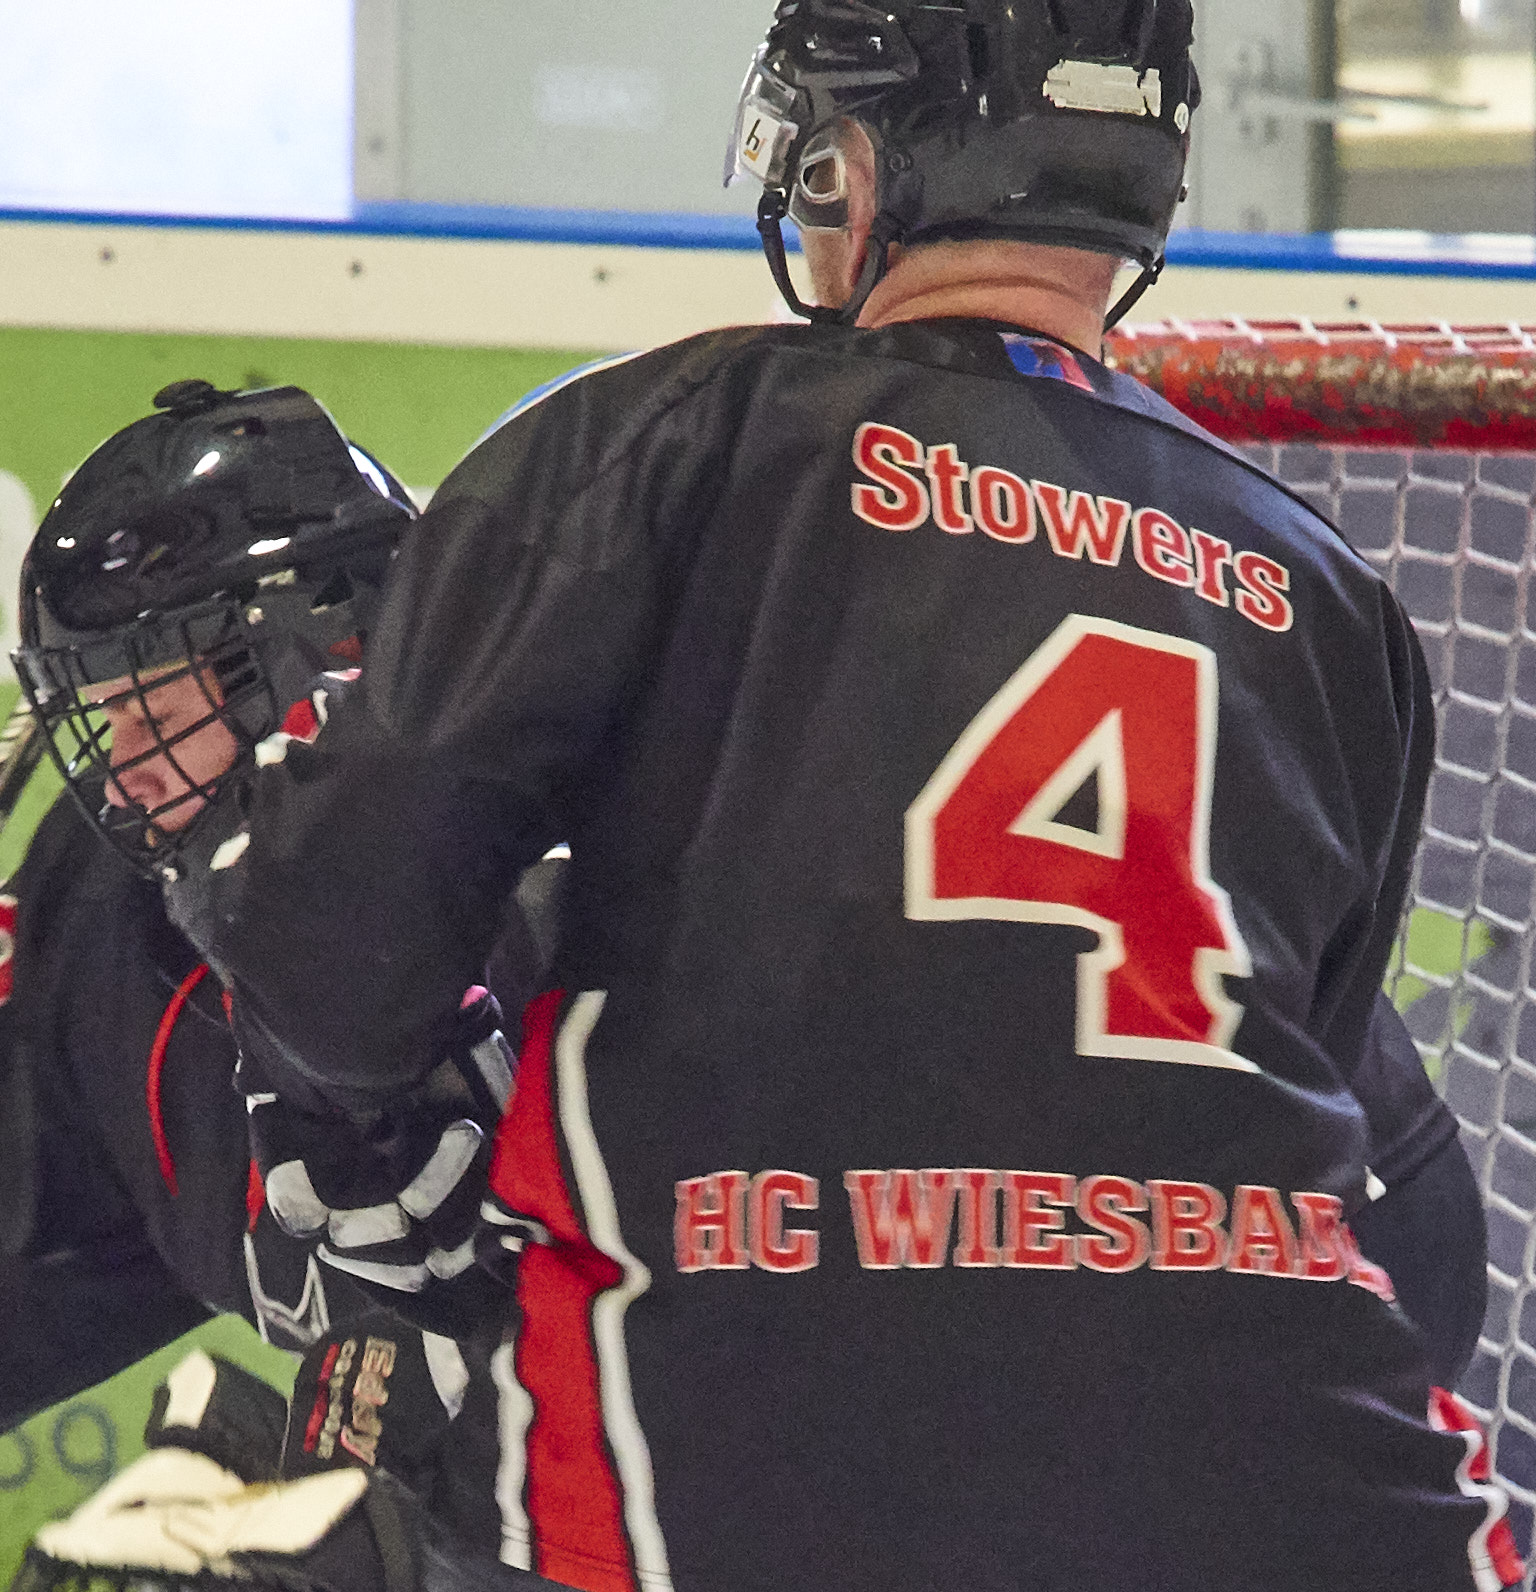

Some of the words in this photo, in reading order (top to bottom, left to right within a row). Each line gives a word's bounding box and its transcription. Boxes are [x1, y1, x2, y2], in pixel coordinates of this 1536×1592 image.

[851, 421, 1293, 633] Stowers
[904, 612, 1263, 1074] 4
[674, 1169, 820, 1275] HC
